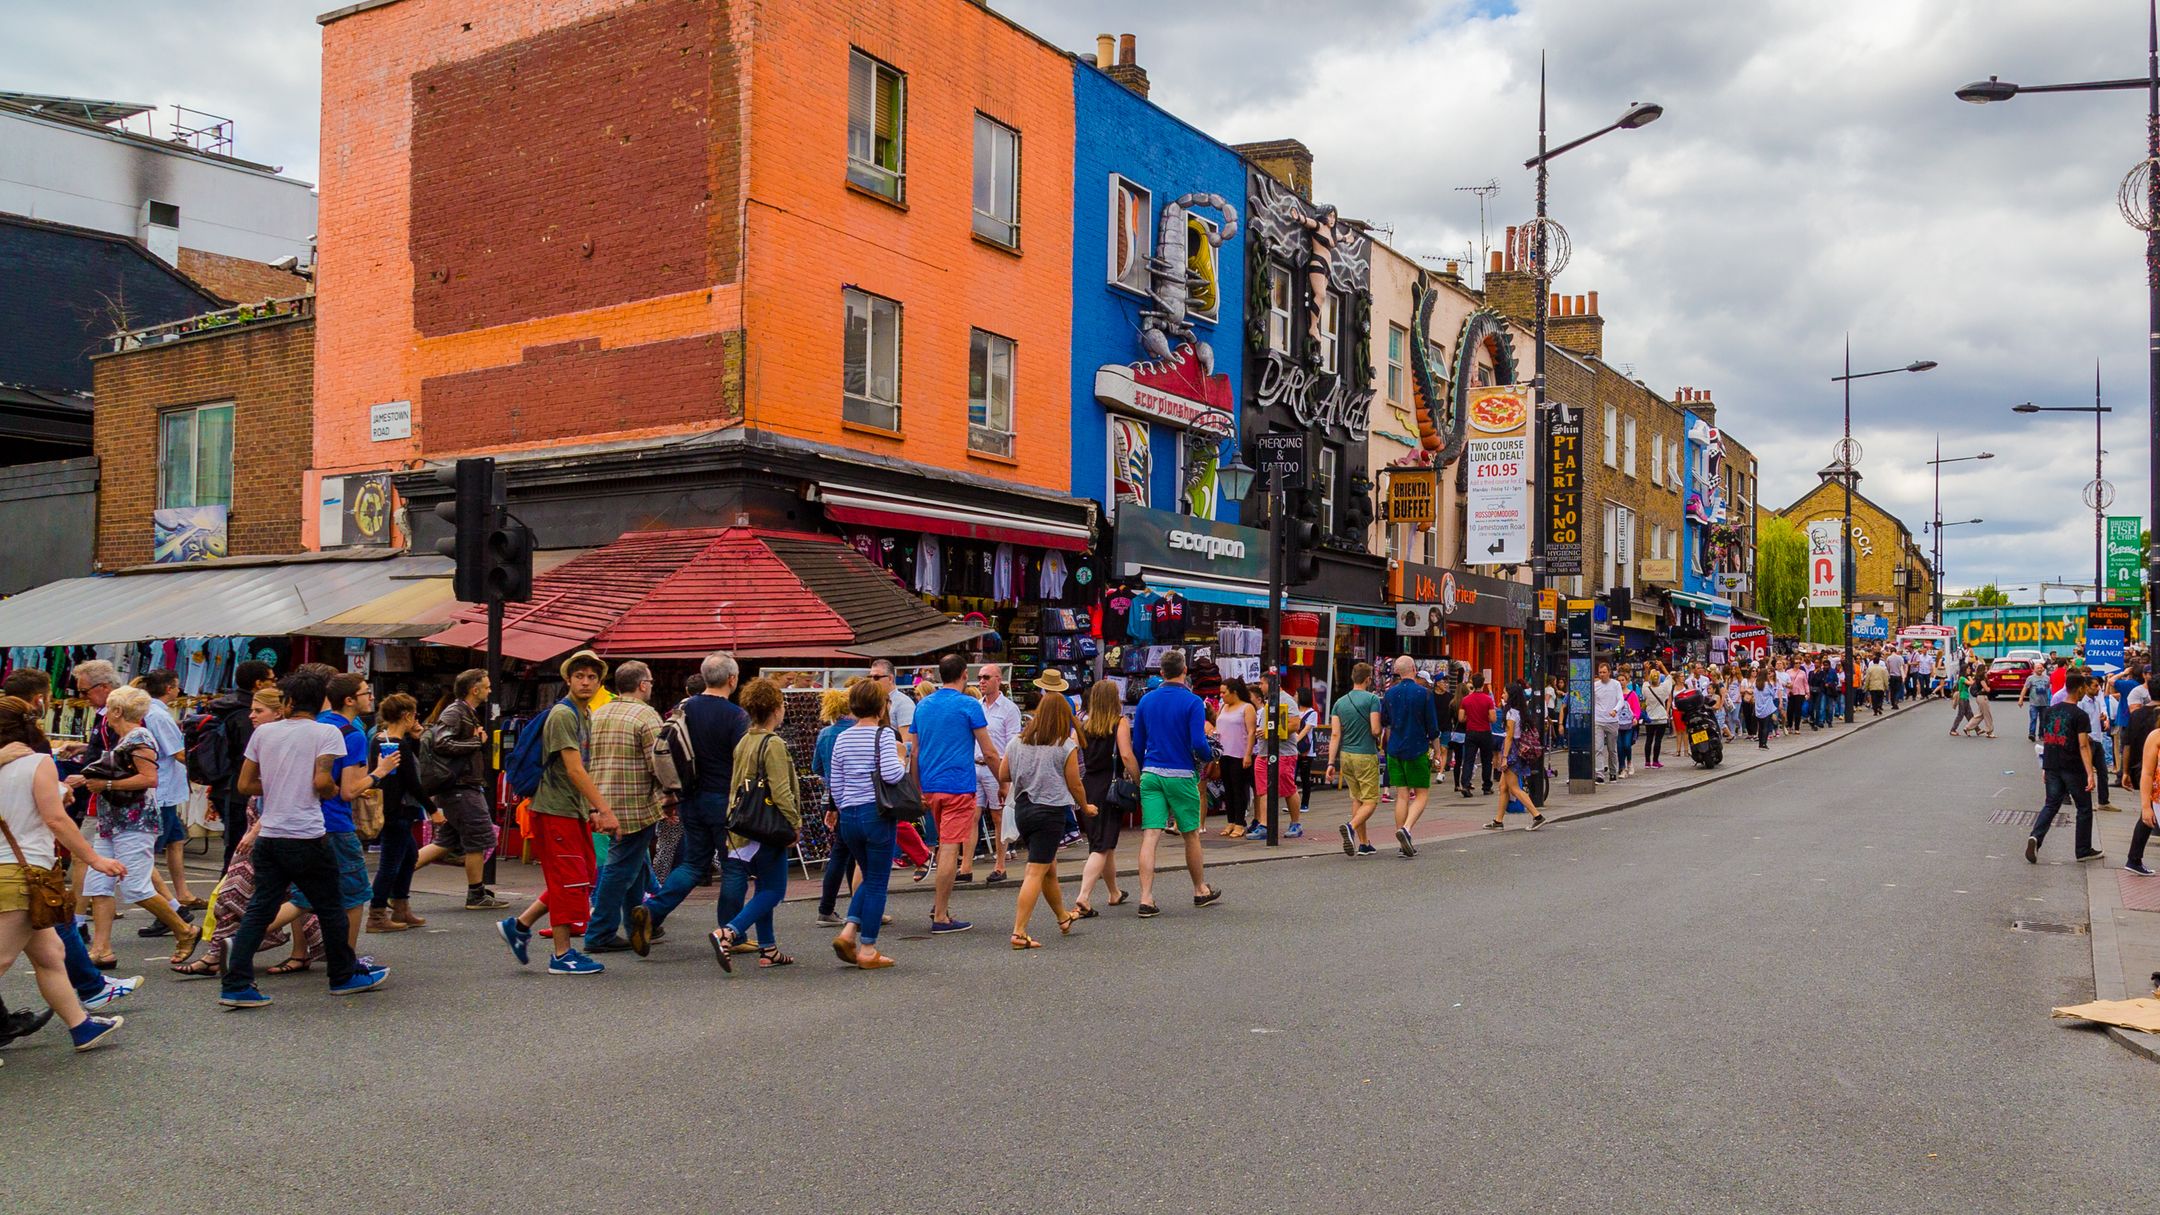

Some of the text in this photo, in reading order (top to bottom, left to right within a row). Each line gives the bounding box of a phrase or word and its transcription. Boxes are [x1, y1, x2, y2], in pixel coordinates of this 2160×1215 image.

[1258, 349, 1319, 428] DARK
[373, 411, 409, 424] JAMESTOWN
[373, 427, 390, 437] ROAD
[1259, 438, 1303, 449] PIERCING
[1470, 440, 1524, 452] TWO COURSE
[1277, 449, 1285, 461] &
[1470, 450, 1524, 462] LUNCH DEAL!
[1262, 461, 1299, 472] TATTOO
[1394, 482, 1430, 497] ORIENTAL
[1565, 437, 1577, 543] TATTOO
[1394, 499, 1430, 518] BUFFET
[1477, 523, 1508, 531] Jamestown
[2110, 526, 2137, 535] FISH
[1169, 530, 1245, 560] scorpion
[1852, 526, 1873, 558] OCK
[1812, 589, 1818, 597] 2
[1730, 629, 1766, 640] Clearance
[1870, 625, 1885, 636] LOCK
[1962, 620, 2065, 647] CAMDEN
[1730, 640, 1765, 661] Sle
